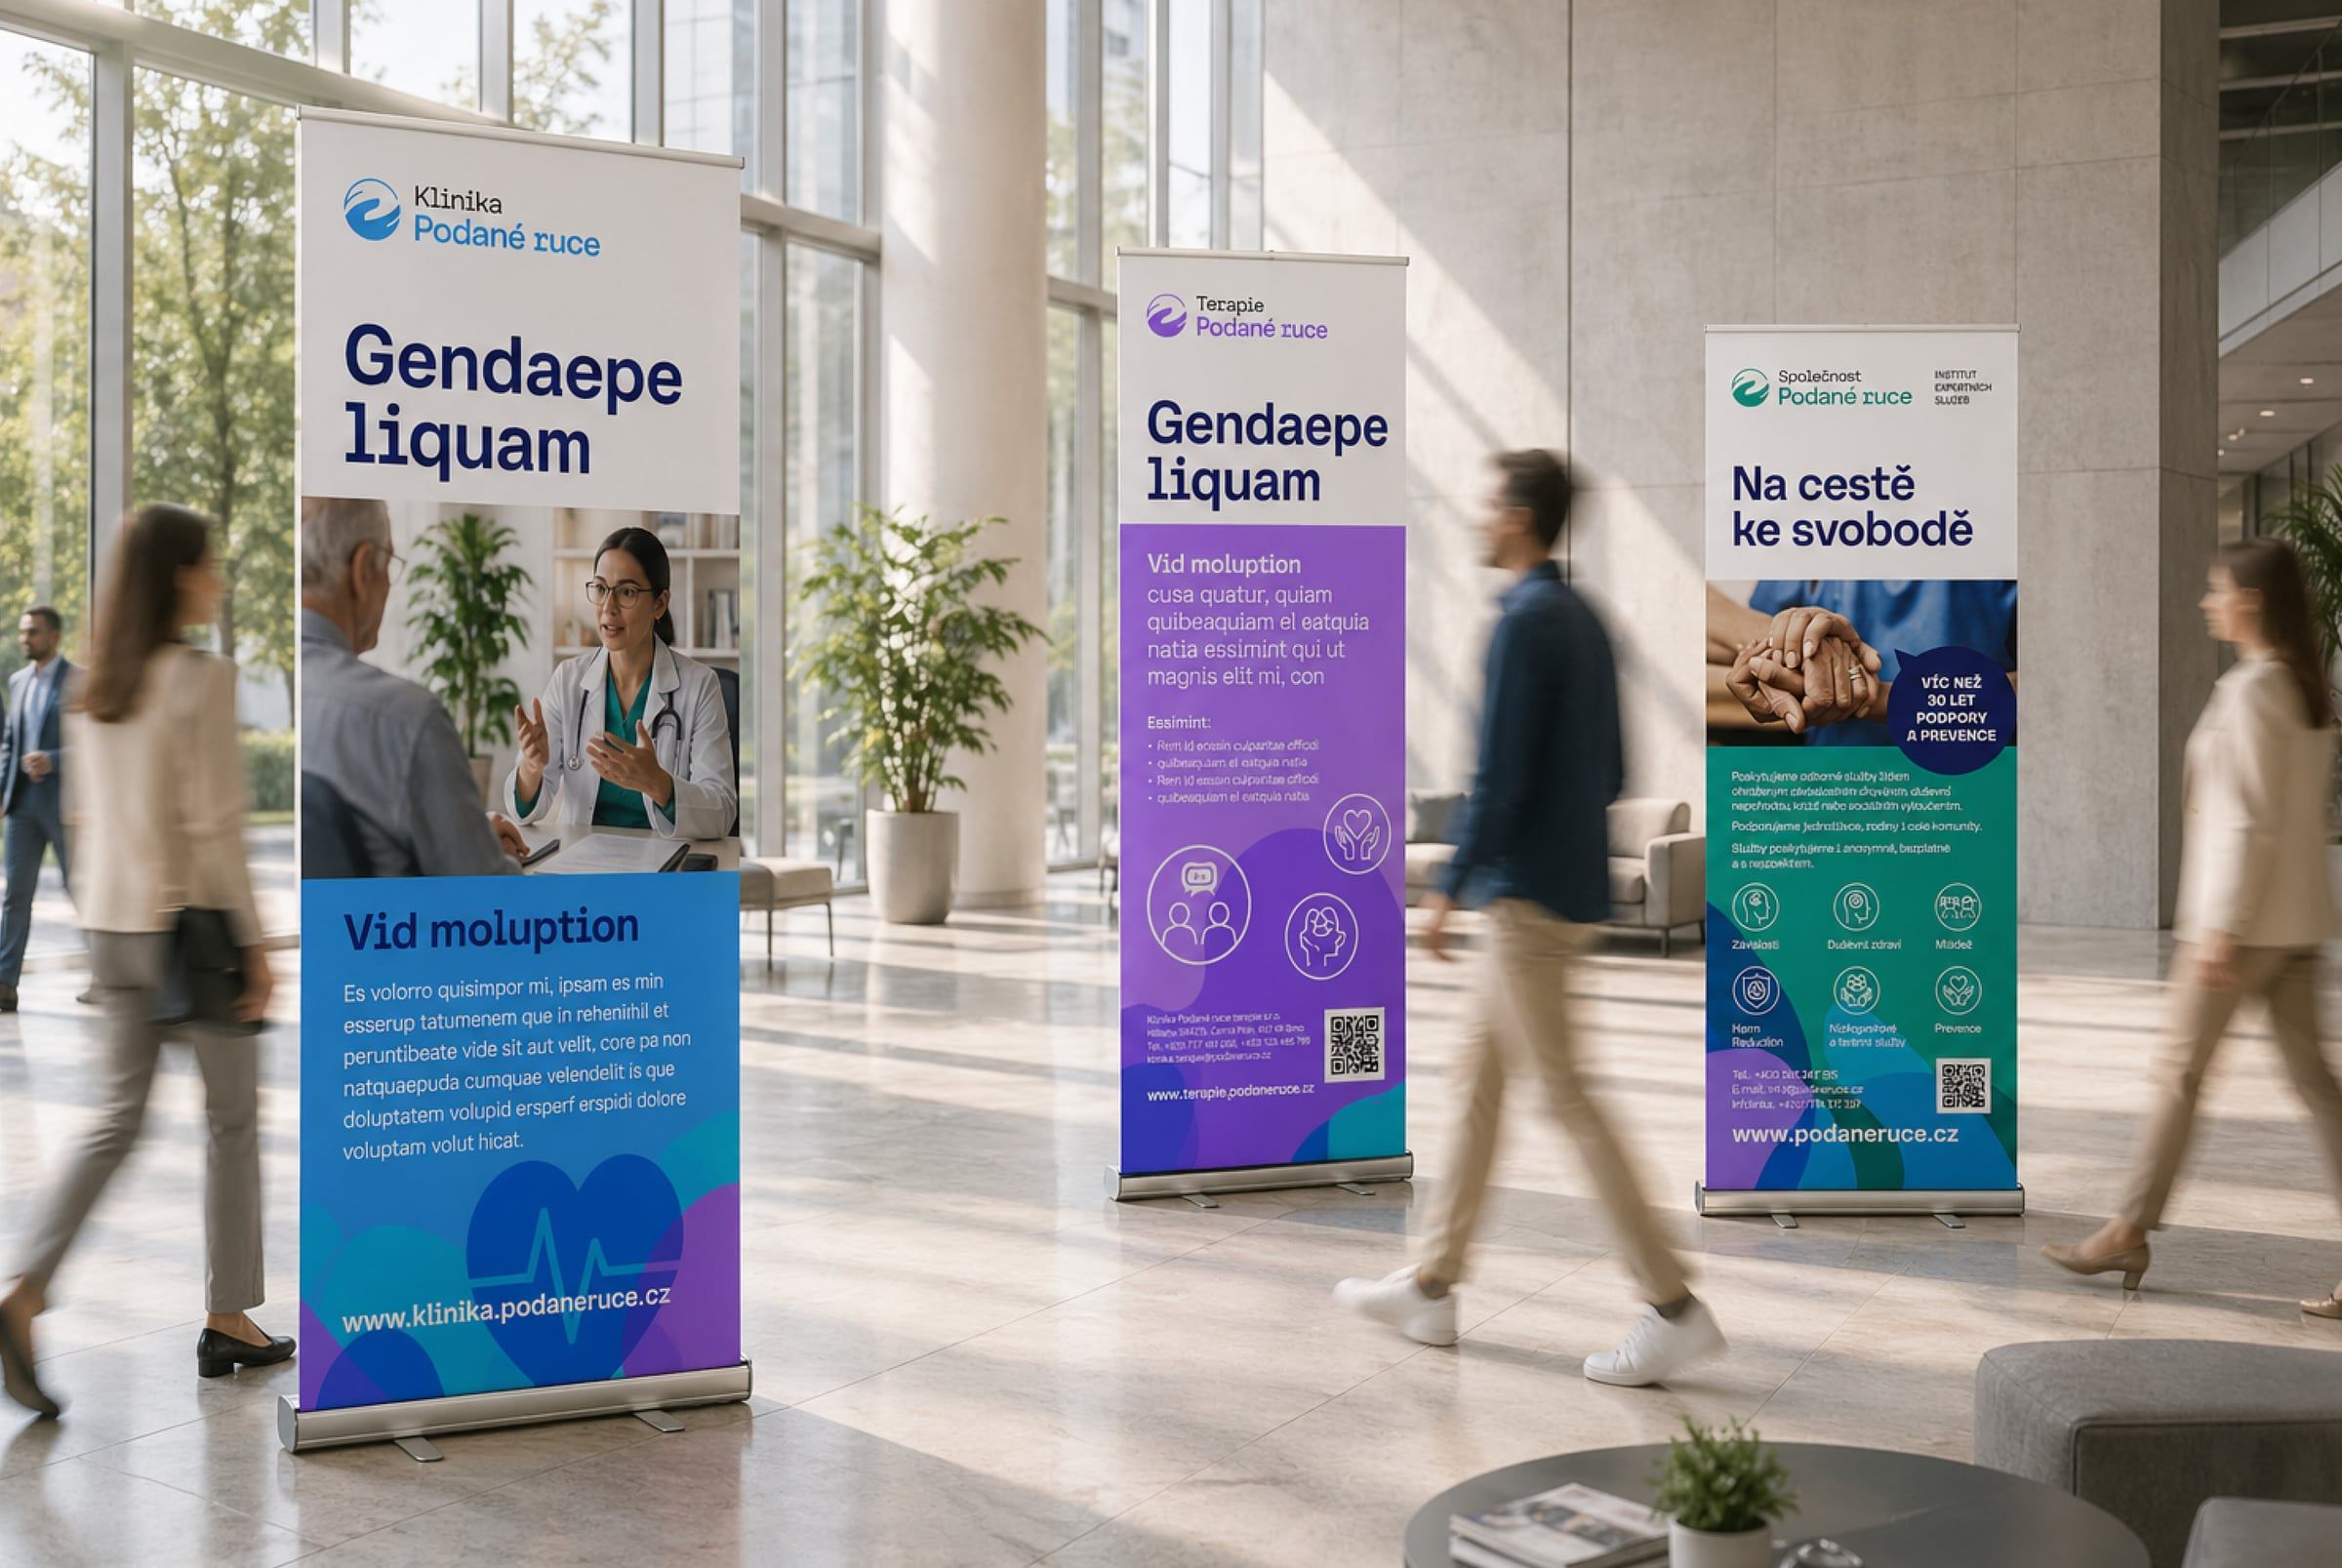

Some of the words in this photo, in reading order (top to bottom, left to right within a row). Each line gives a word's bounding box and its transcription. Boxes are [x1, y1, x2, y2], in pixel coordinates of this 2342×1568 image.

[415, 185, 503, 215] Klinika
[415, 215, 525, 250] Podané
[534, 230, 600, 257] ruce
[1196, 296, 1265, 316] Terapie
[1196, 316, 1276, 338] Podané
[1280, 321, 1328, 339] ruce
[345, 323, 682, 415] Gendaepe
[1779, 370, 1862, 384] Společnost
[1779, 386, 1857, 406] Podané
[1863, 391, 1913, 406] ruce
[345, 401, 589, 482] liquam
[1148, 399, 1388, 457] Gendaepe
[1148, 456, 1320, 511] liquam
[1733, 465, 1787, 502] Na
[1798, 464, 1915, 502] cestě
[1733, 510, 1780, 546] ke
[1792, 509, 1973, 546] svobodě
[1148, 553, 1184, 574] Vid
[1191, 553, 1302, 578] moluption
[1148, 588, 1194, 603] cusa
[1200, 586, 1270, 607] quatur,
[1275, 586, 1332, 608] quiam
[1148, 612, 1274, 635] quibeaquiam
[1280, 612, 1296, 630] el
[1302, 613, 1369, 634] eatquia
[1148, 640, 1197, 659] natia
[1204, 639, 1288, 659] essimint
[1292, 639, 1321, 663] qui
[1326, 641, 1346, 659] ut
[1148, 666, 1217, 690] magnis
[1223, 665, 1254, 685] elit
[1259, 665, 1285, 688] mi,
[1290, 670, 1324, 685] con
[1921, 673, 1950, 689] VÍC
[1954, 673, 1983, 689] NEŽ
[1927, 694, 1947, 706] 30
[1950, 694, 1976, 706] LET
[1148, 716, 1211, 729] Essimint:
[1917, 711, 1987, 725] PODPORY
[1907, 730, 1918, 742] A
[1920, 730, 1997, 742] PREVENCE
[343, 912, 418, 950] Vid
[430, 906, 639, 954] moluption
[343, 985, 365, 1003] Es
[371, 983, 432, 1001] volorro
[439, 979, 523, 1002] quisimpor
[529, 978, 554, 997] mi,
[559, 976, 607, 996] ipsam
[612, 977, 630, 991] es
[635, 973, 664, 990] min
[343, 1016, 415, 1036] esserup
[421, 1010, 517, 1031] tatumenem
[522, 1010, 552, 1028] que
[557, 1007, 572, 1025] in
[654, 1003, 669, 1019] et
[1935, 1024, 1982, 1033] Prevence
[343, 1043, 457, 1069] peruntibeate
[462, 1040, 498, 1060] vide
[503, 1038, 523, 1057] sit
[527, 1037, 554, 1056] aut
[558, 1035, 596, 1055] velit,
[600, 1034, 635, 1051] core
[639, 1033, 658, 1053] pa
[664, 1031, 691, 1047] non
[343, 1075, 460, 1101] natquaepuda
[465, 1071, 542, 1092] cumquae
[547, 1064, 626, 1084] velendelit
[629, 1063, 641, 1079] is
[646, 1062, 675, 1081] que
[343, 1106, 444, 1129] doluptatem
[450, 1100, 511, 1123] volupid
[516, 1096, 575, 1119] ersperf
[579, 1093, 632, 1114] erspidi
[637, 1091, 686, 1108] dolore
[343, 1138, 426, 1161] voluptam
[432, 1136, 474, 1154] volut
[478, 1132, 524, 1150] hicat.
[1732, 1124, 1958, 1146] www.podaneruce.cz
[343, 1286, 671, 1334] www.klinika.podaneruce.cz
